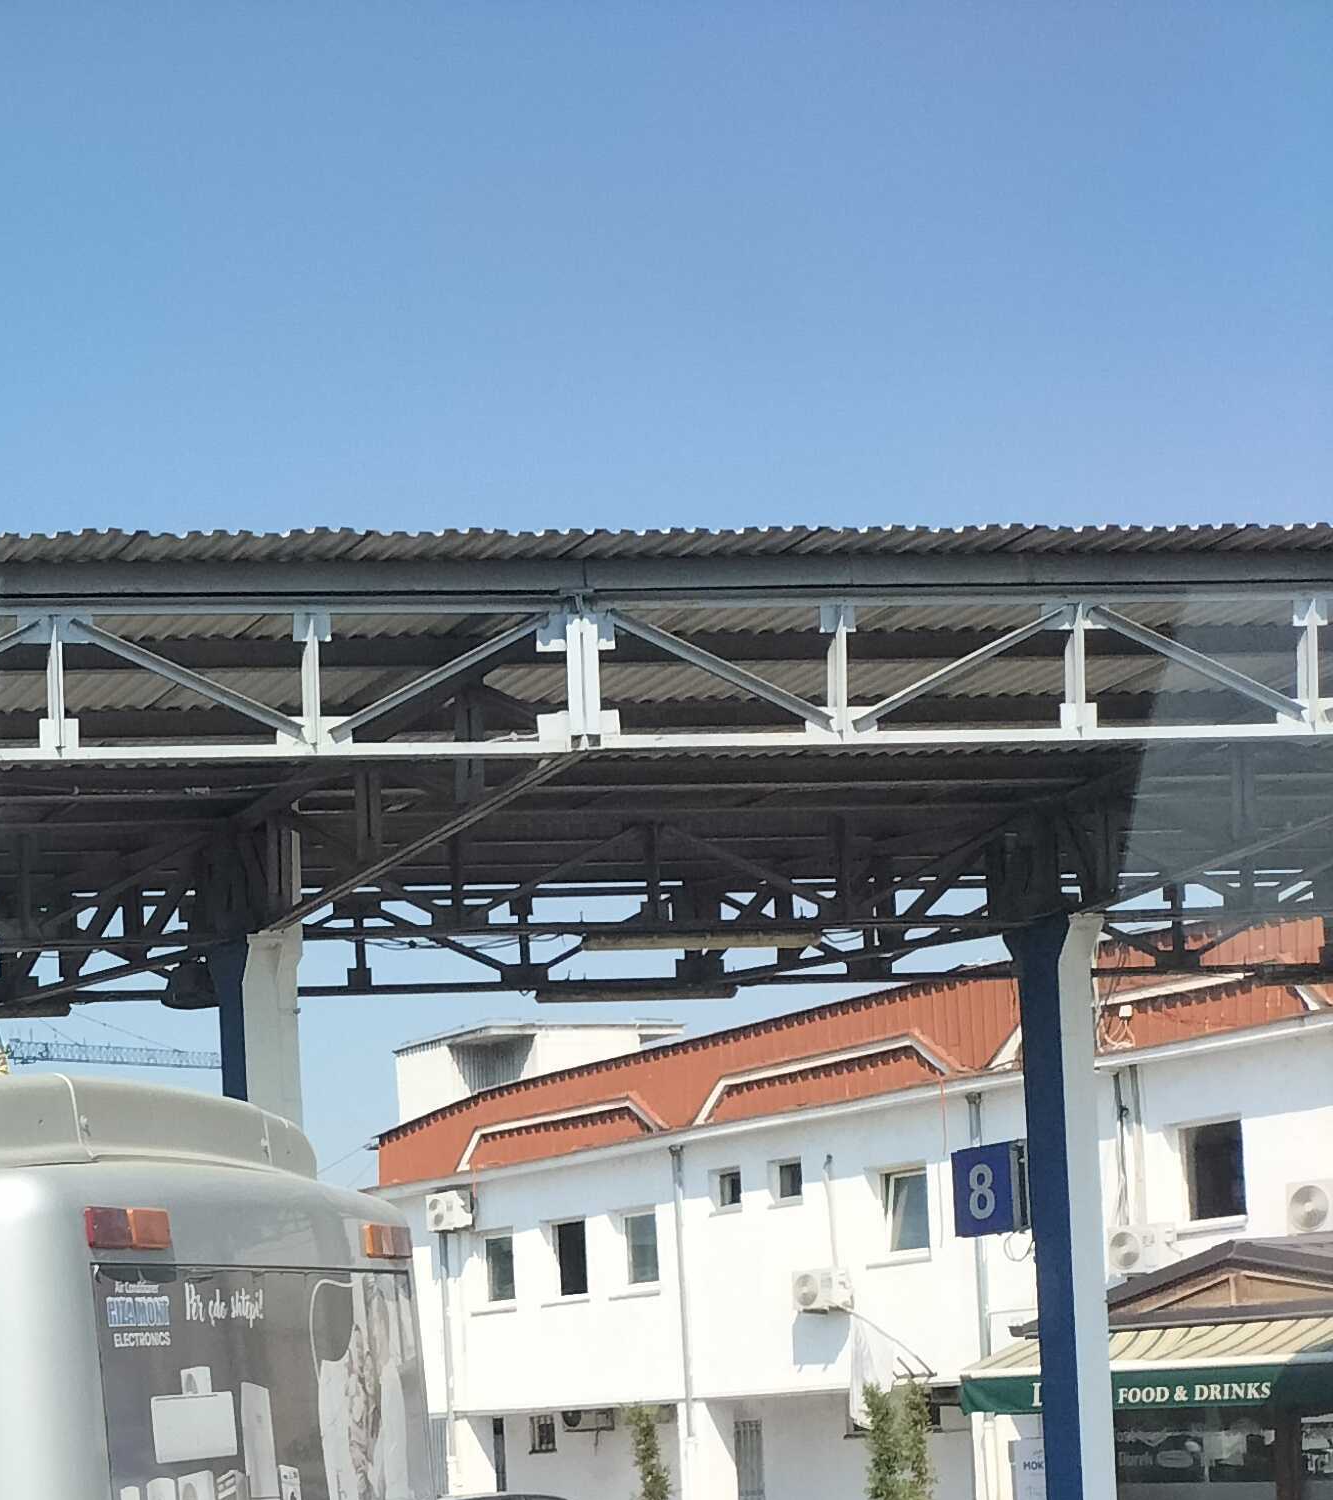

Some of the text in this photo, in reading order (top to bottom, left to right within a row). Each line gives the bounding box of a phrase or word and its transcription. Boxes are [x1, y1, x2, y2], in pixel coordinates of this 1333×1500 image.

[969, 1163, 996, 1220] 8
[114, 1331, 171, 1347] ELECTRONICS
[1118, 1381, 1272, 1404] FOOD & DRINKS
